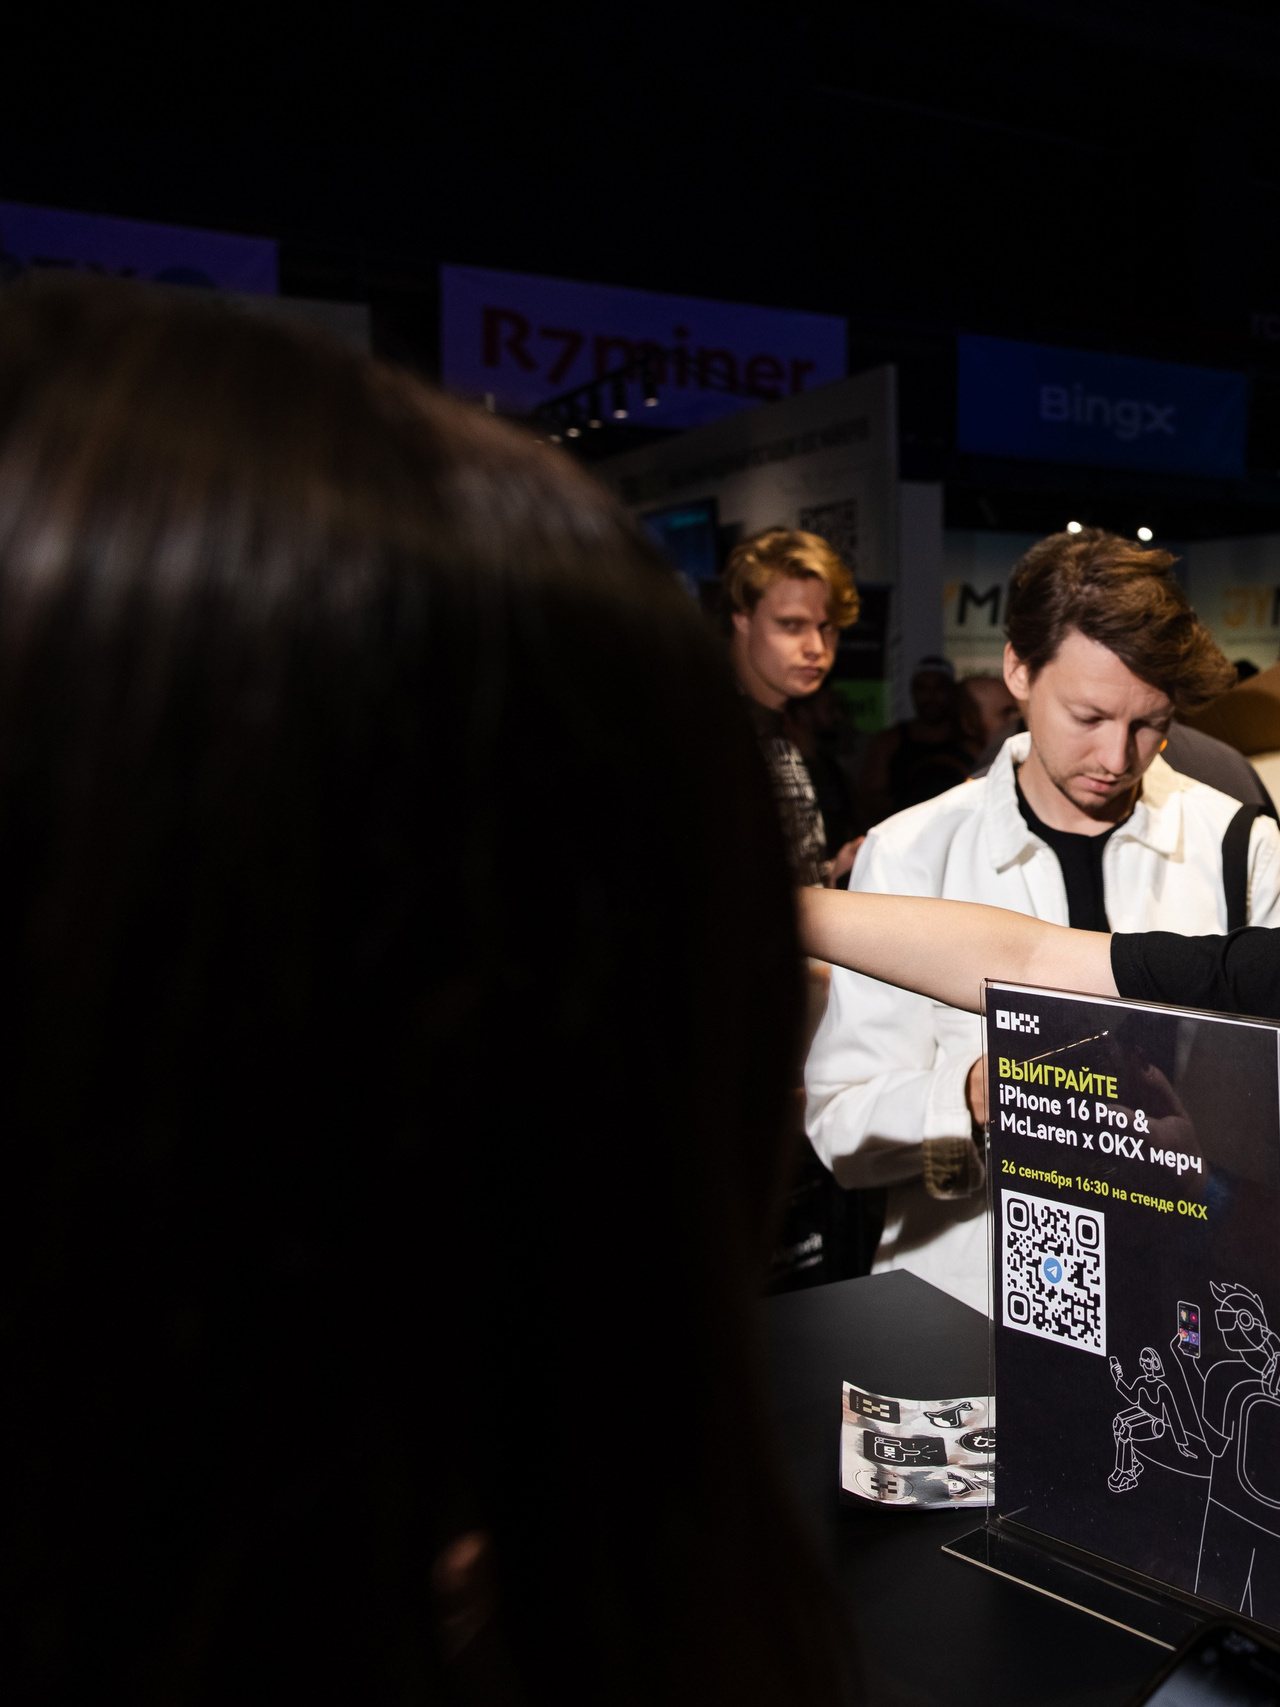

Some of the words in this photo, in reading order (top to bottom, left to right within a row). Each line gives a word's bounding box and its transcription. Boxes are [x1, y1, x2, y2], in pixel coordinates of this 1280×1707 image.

[483, 306, 816, 400] R7miner
[996, 1009, 1040, 1035] OKX
[998, 1056, 1118, 1099] ВЫИГРАЙТЕ
[999, 1084, 1062, 1116] iPhone
[1067, 1098, 1089, 1122] 16
[1095, 1103, 1128, 1129] Pro
[1134, 1109, 1150, 1134] &
[1000, 1113, 1077, 1147] McLaren
[1098, 1132, 1144, 1161] OKX
[1150, 1147, 1203, 1176] мерч
[1001, 1160, 1017, 1175] 26
[1018, 1164, 1073, 1189] сентября
[1075, 1176, 1110, 1198] 16:30
[1111, 1187, 1128, 1201] на
[1130, 1191, 1175, 1213] стенде
[1177, 1200, 1208, 1221] OKX
